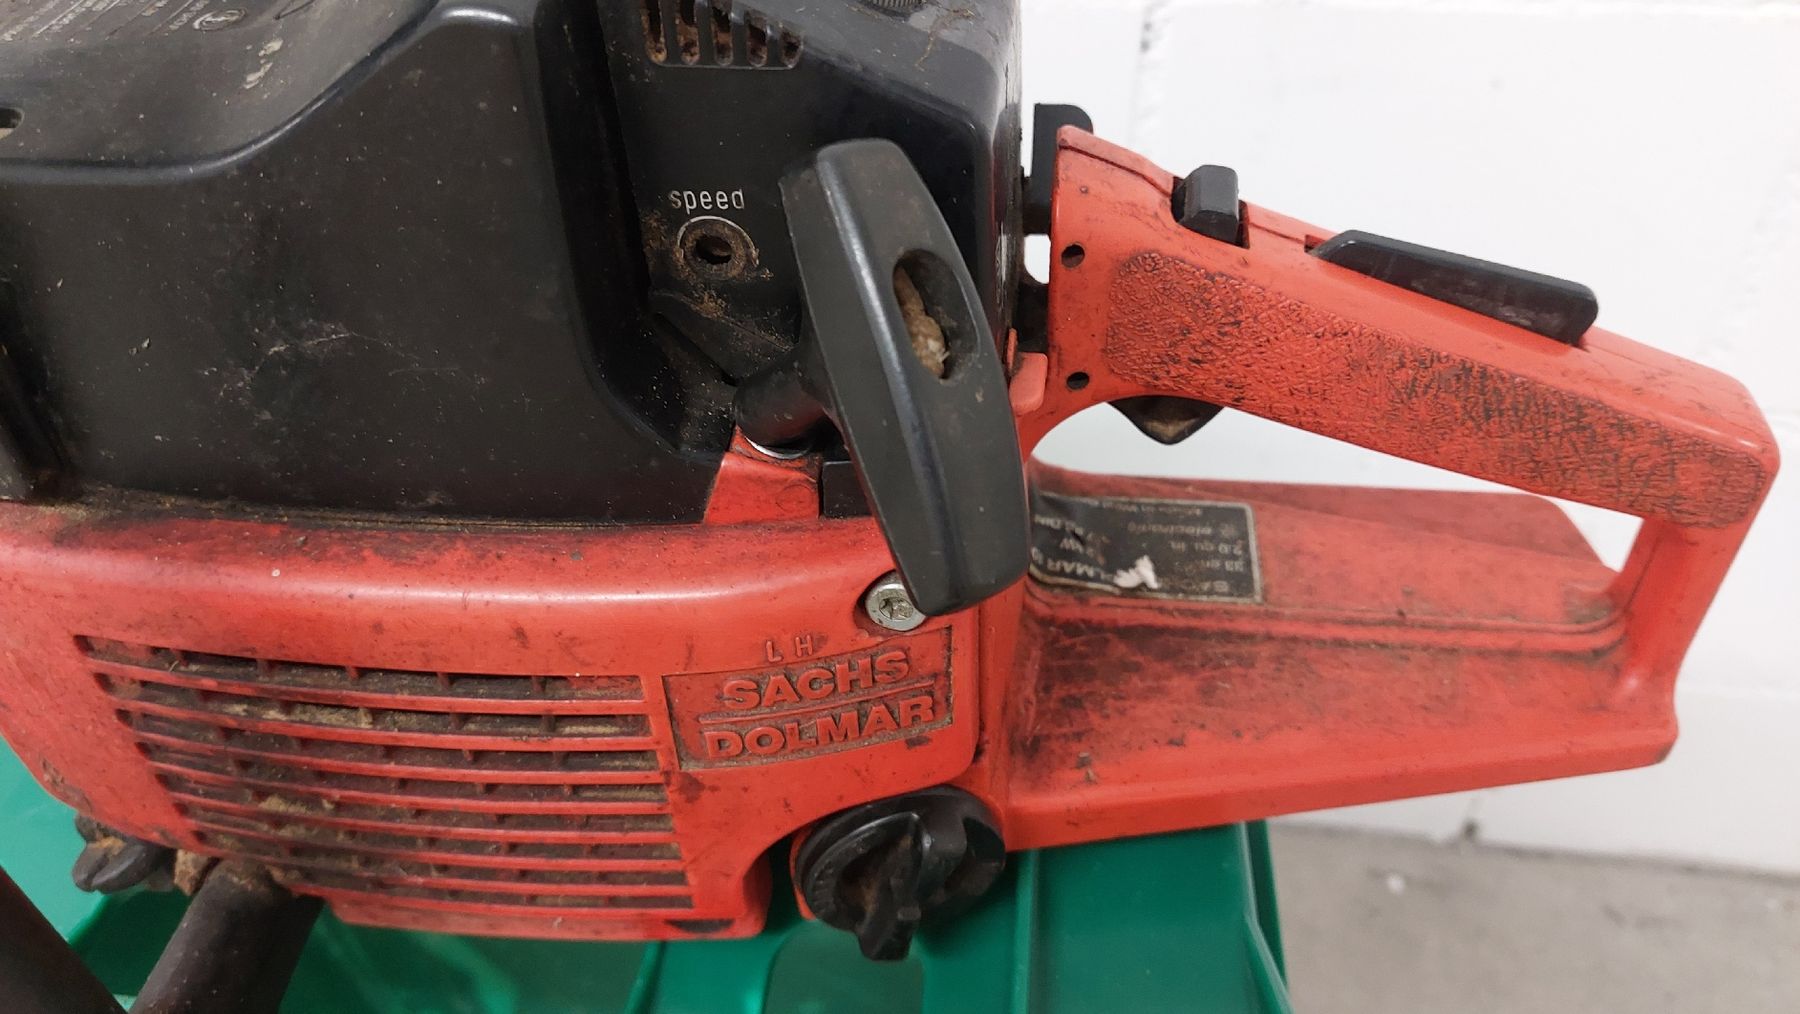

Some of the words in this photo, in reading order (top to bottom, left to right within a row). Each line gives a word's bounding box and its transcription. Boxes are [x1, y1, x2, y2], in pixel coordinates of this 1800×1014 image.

[669, 188, 745, 215] speed
[722, 649, 910, 711] SACHS
[703, 694, 936, 761] DOLMAR
